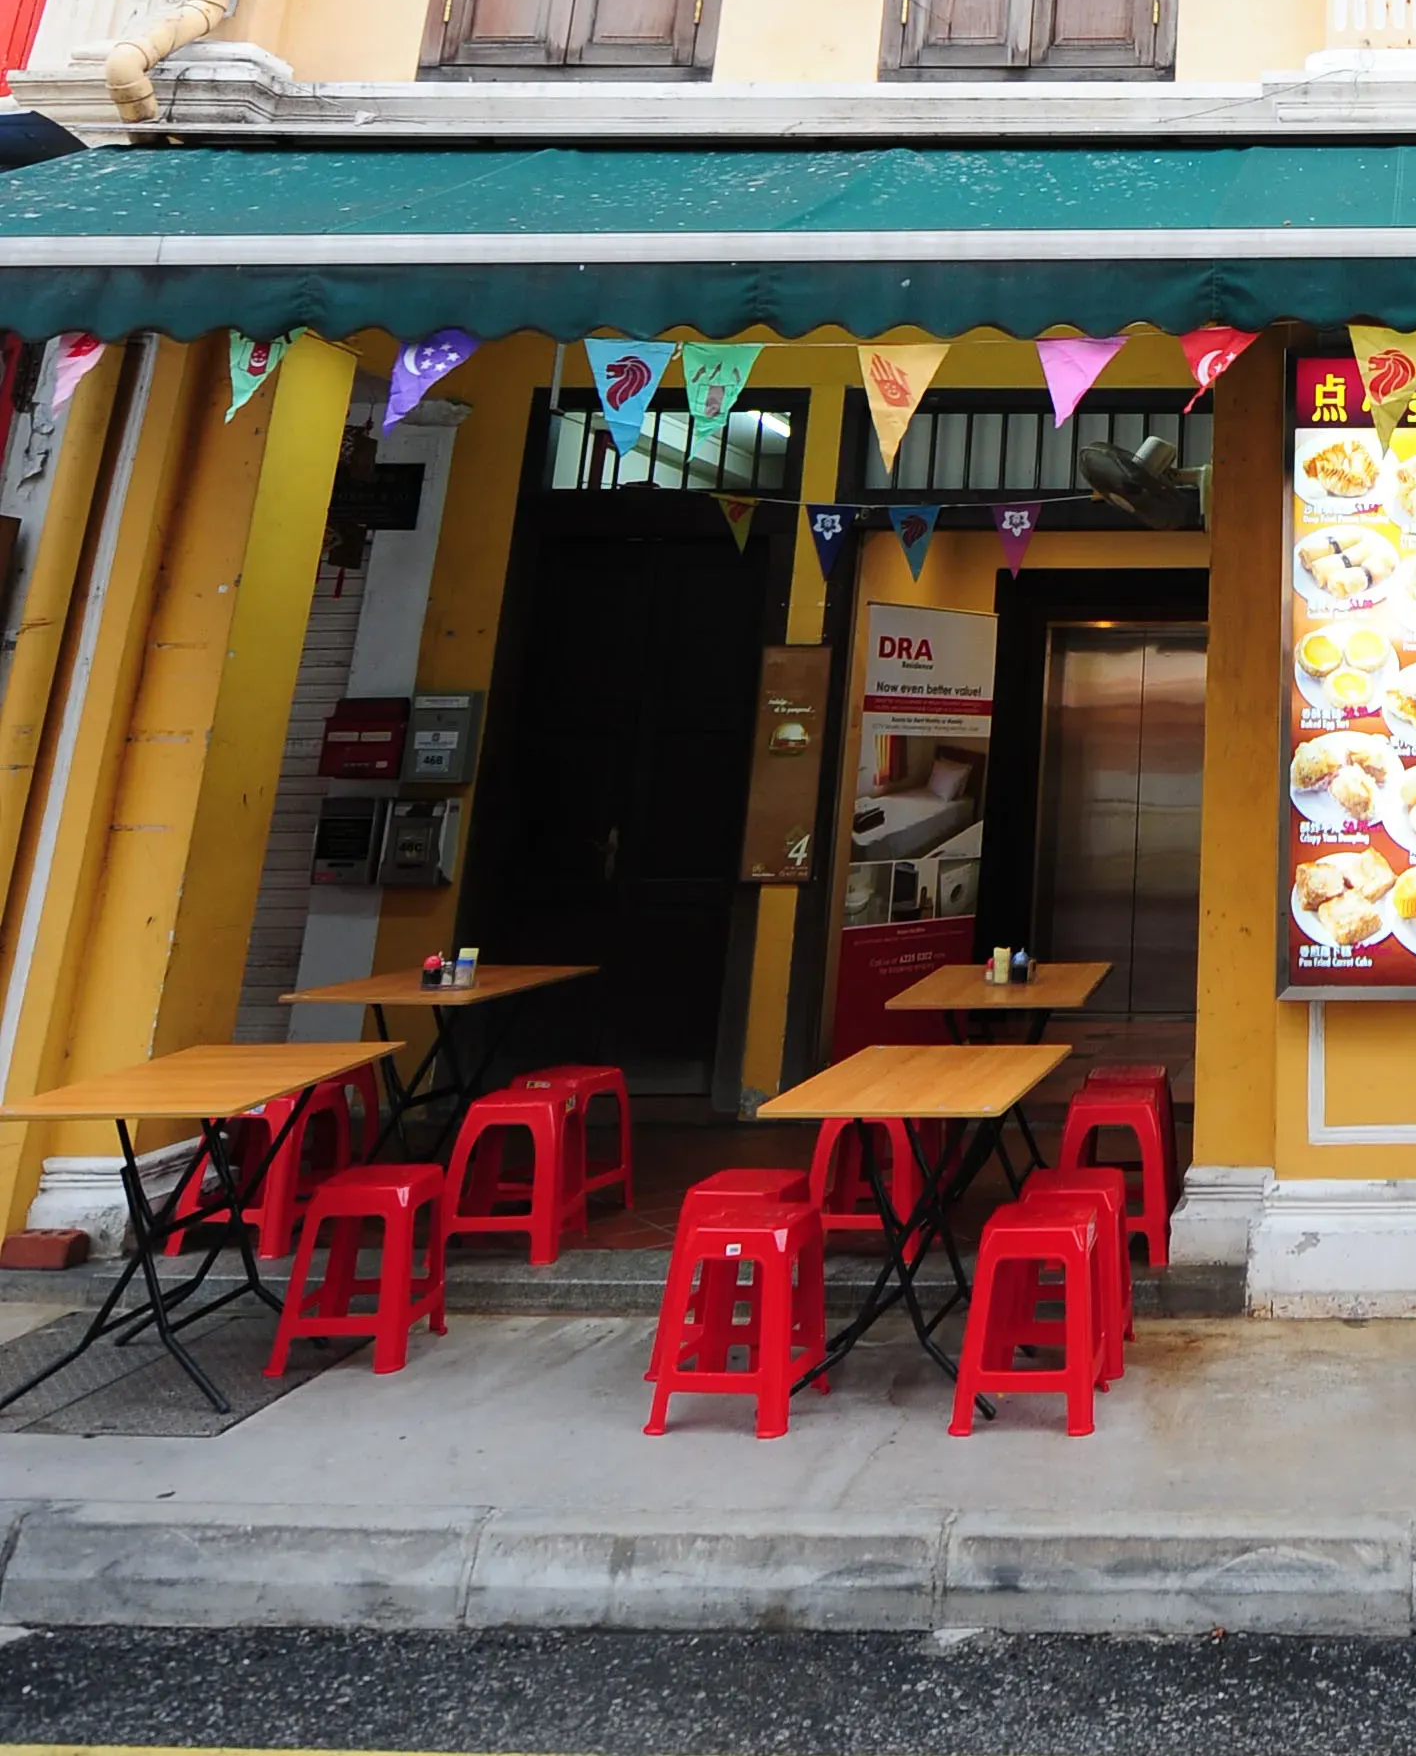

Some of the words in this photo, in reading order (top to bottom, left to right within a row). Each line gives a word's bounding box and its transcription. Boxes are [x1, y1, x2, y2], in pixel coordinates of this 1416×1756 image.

[879, 635, 934, 661] DRA
[876, 681, 898, 693] Now
[900, 685, 924, 694] even
[926, 684, 952, 695] better
[954, 686, 982, 697] value!
[787, 834, 811, 866] 4
